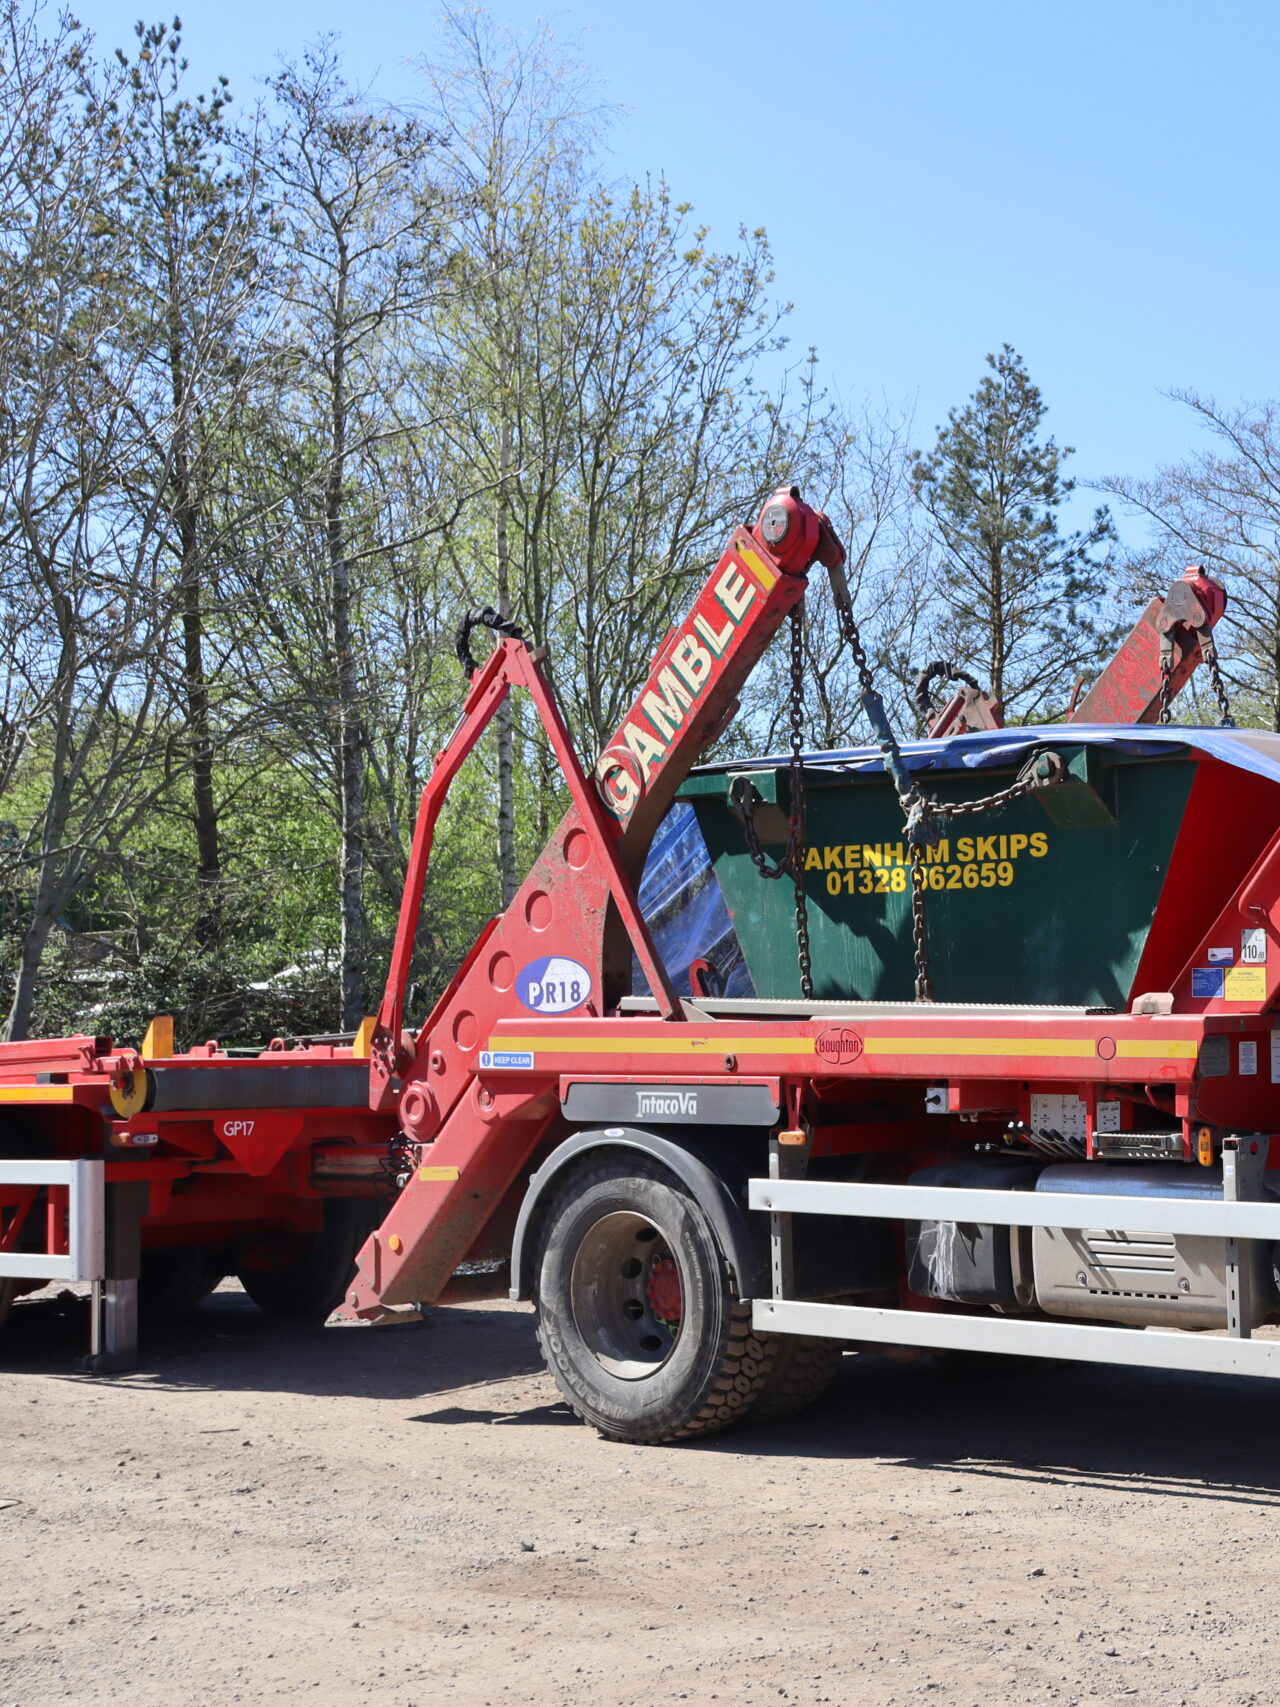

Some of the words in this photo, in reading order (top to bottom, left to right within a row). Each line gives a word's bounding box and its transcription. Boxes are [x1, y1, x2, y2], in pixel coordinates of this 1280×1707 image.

[595, 561, 757, 820] GAMBLE
[793, 839, 949, 870] AKENHAM
[956, 832, 1048, 862] SKIPS
[826, 868, 907, 895] 01328
[1243, 944, 1257, 960] 110
[528, 980, 581, 1005] PR18
[494, 1056, 510, 1064] KEEP
[511, 1056, 531, 1065] CLEAR
[223, 1120, 255, 1137] GP17
